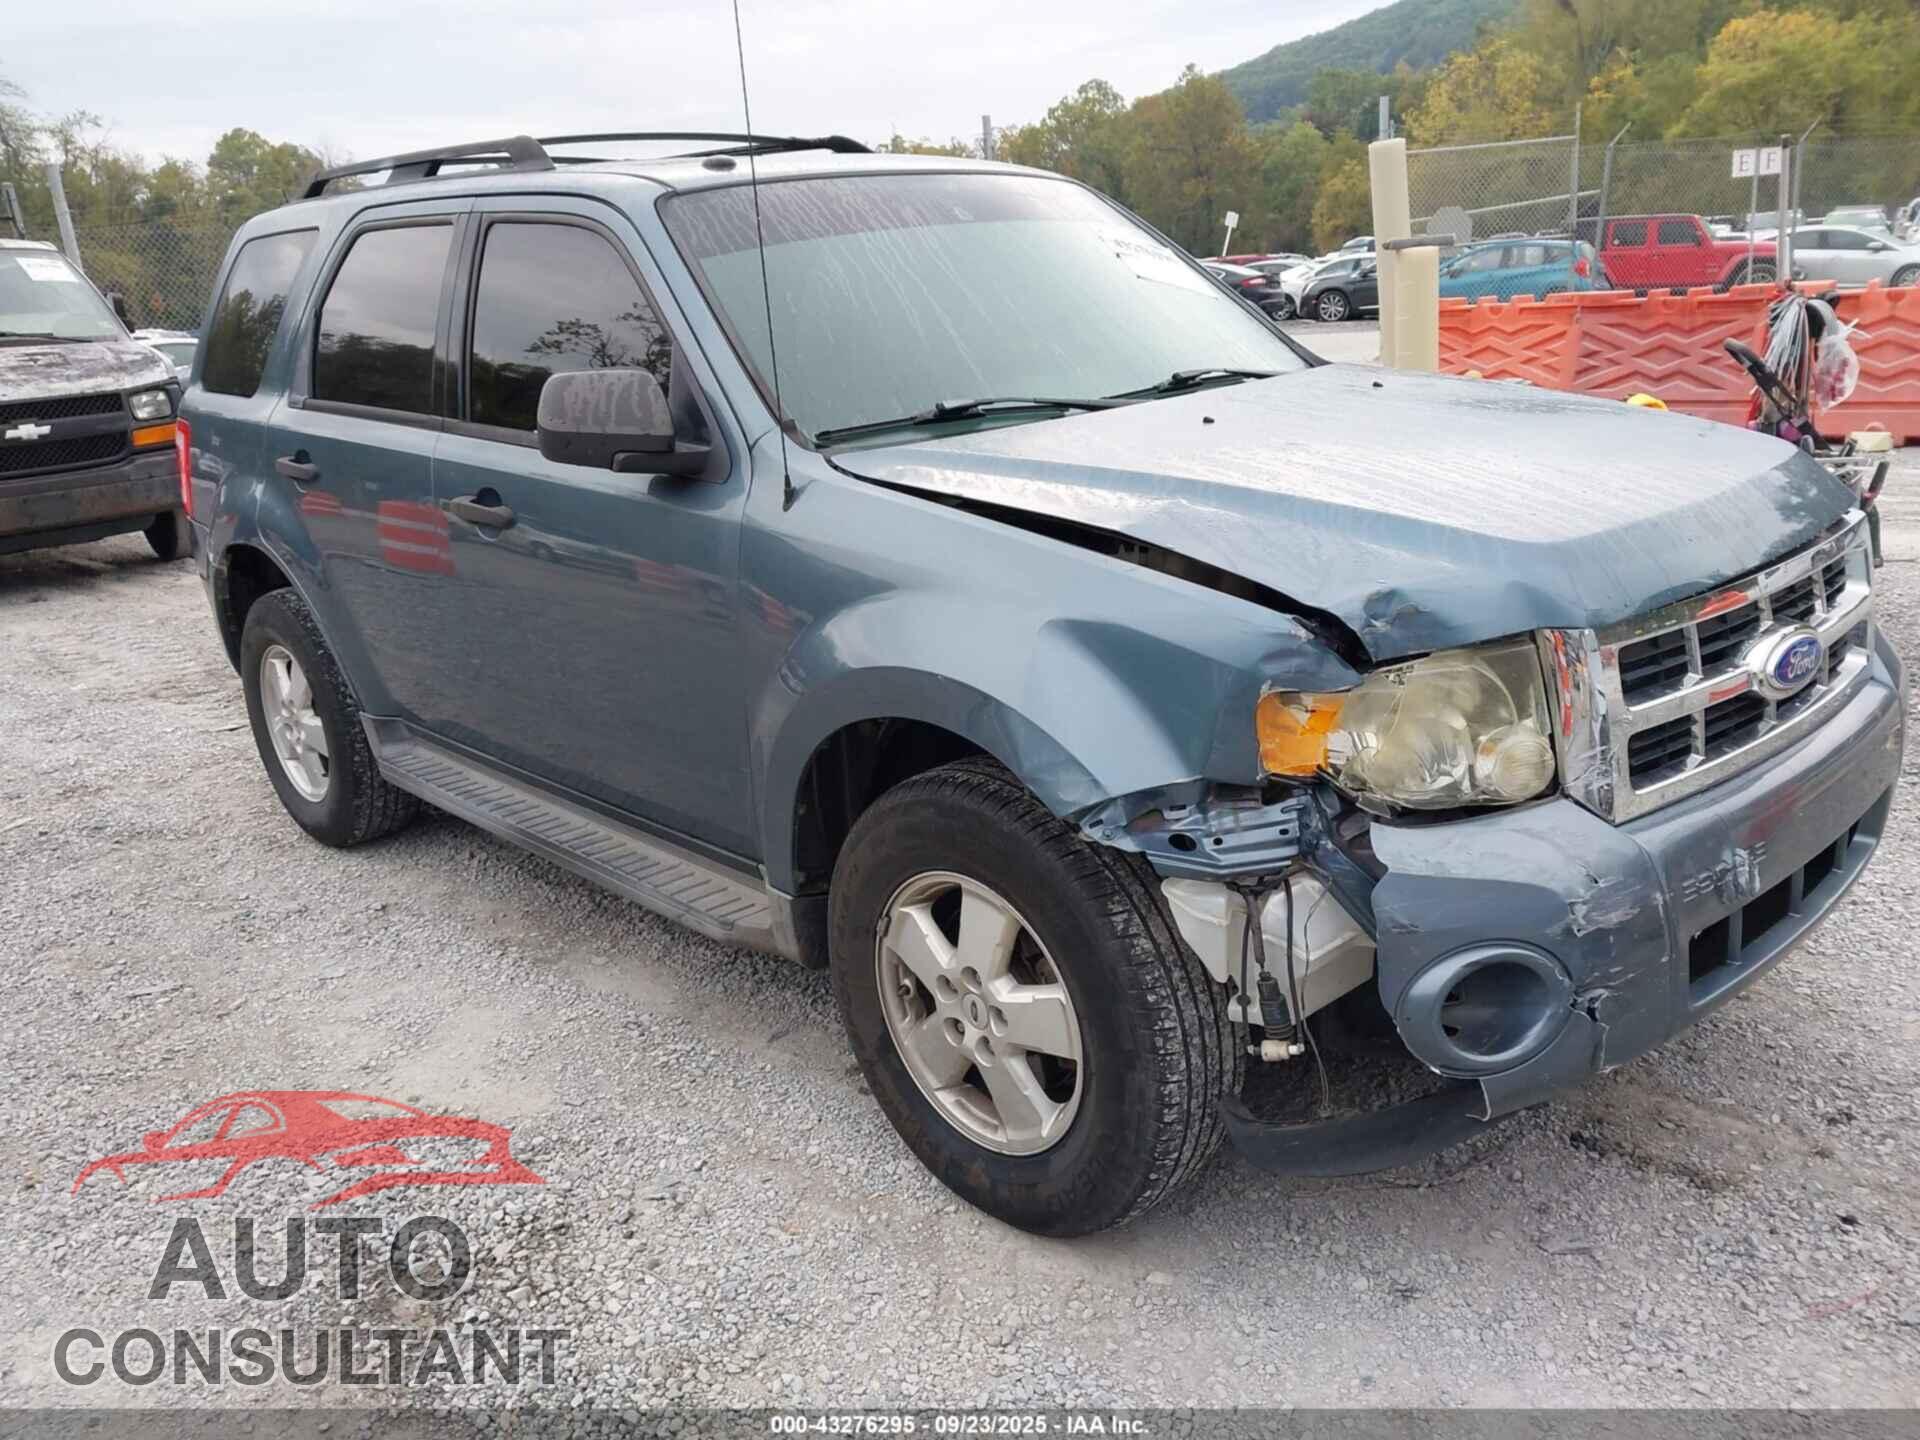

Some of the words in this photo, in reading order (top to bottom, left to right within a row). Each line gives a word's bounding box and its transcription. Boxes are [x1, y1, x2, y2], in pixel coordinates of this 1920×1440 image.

[1739, 154, 1751, 171] E
[1765, 151, 1777, 170] F
[1788, 645, 1817, 678] Ford
